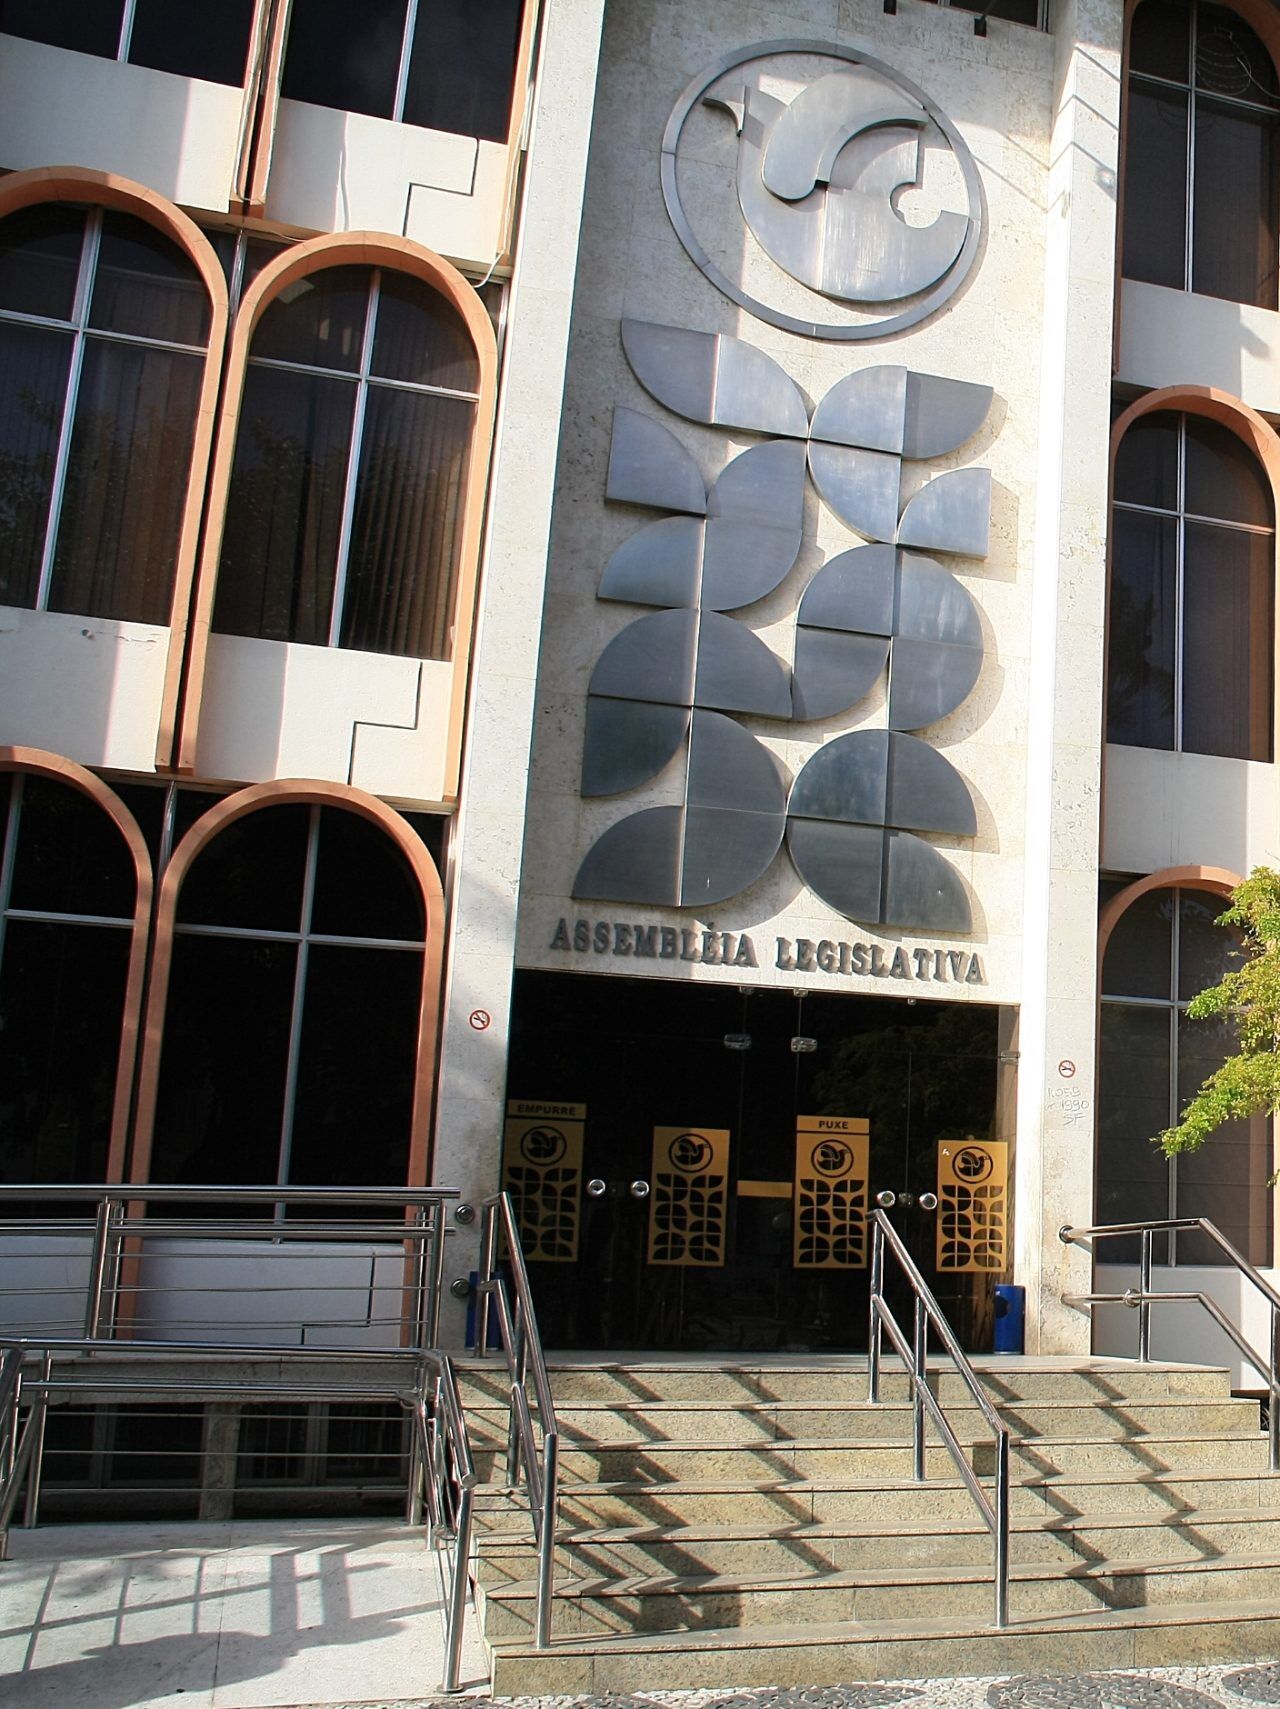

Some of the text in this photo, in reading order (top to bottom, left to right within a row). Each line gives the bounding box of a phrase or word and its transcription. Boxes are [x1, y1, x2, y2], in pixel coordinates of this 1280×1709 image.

[549, 918, 989, 986] ASSEMBLÉIA LEGISLATIVA
[516, 1103, 577, 1116] EMPURRE
[817, 1119, 849, 1130] PUXE
